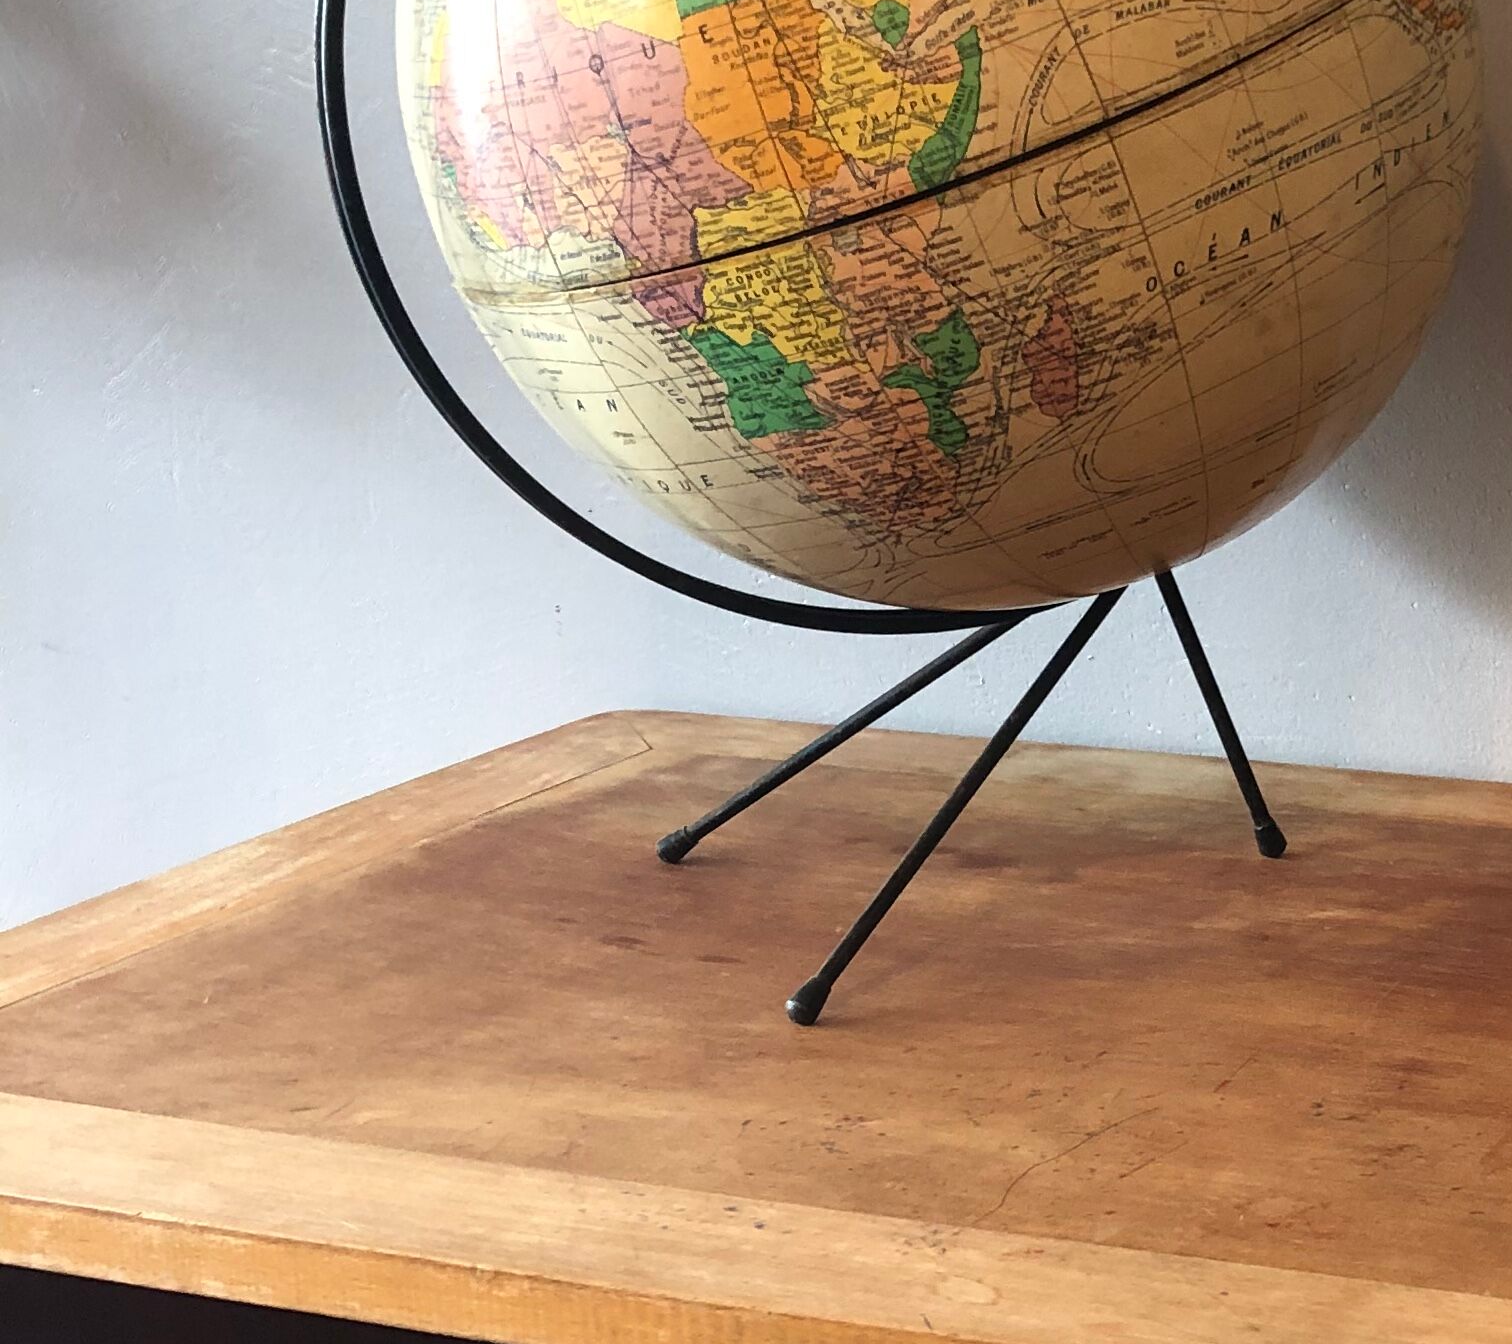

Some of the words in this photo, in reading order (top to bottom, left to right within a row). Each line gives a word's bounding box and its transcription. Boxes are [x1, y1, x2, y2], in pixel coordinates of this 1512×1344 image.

[711, 37, 771, 65] SOUDAN
[1028, 45, 1061, 107] COURANT
[1073, 23, 1091, 40] DE
[1194, 175, 1252, 210] COURANT
[725, 268, 771, 286] CONGO
[1145, 208, 1284, 293] OCÉAN
[588, 333, 604, 345] DU
[657, 379, 688, 406] SUD
